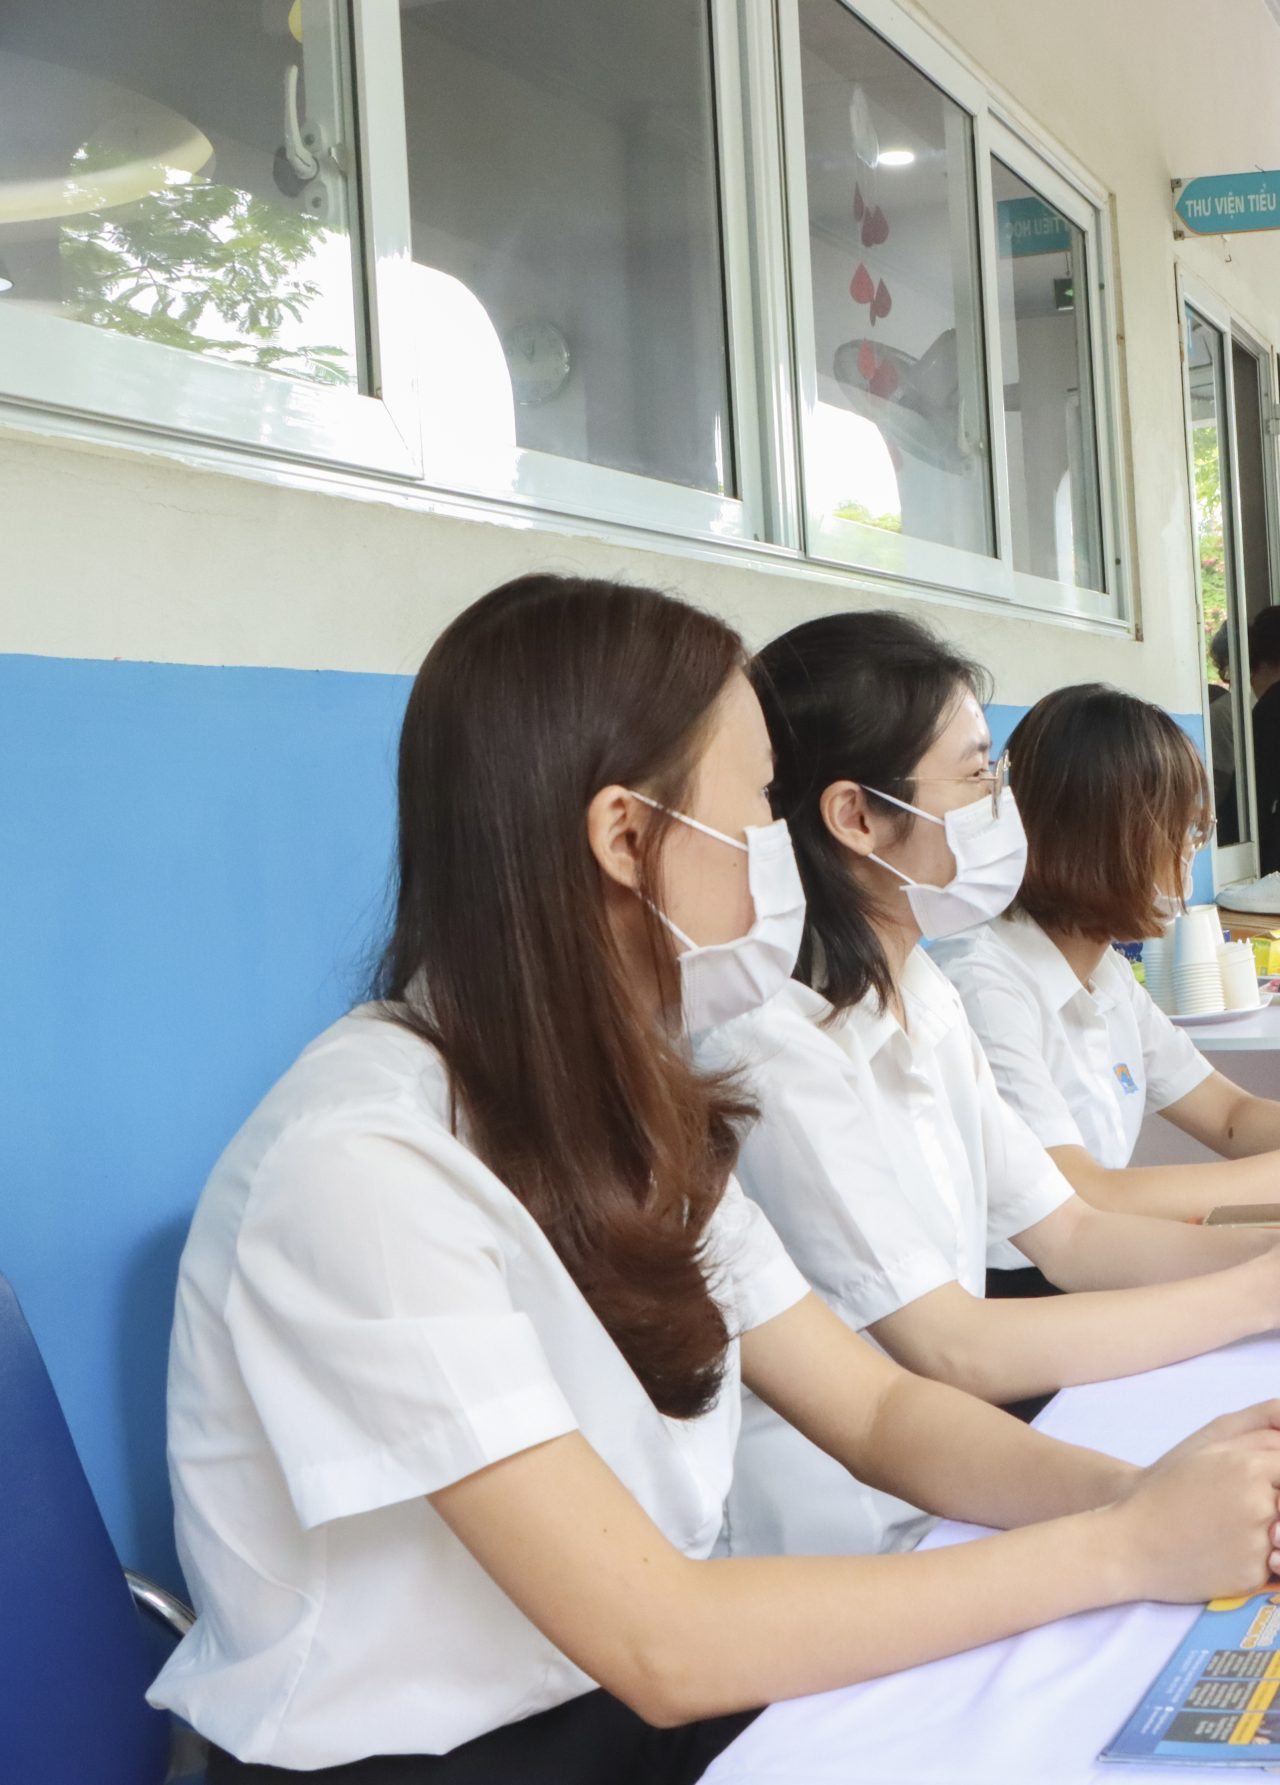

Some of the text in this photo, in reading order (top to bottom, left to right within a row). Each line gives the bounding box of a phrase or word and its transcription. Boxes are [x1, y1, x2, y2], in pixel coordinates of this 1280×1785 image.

[1185, 196, 1212, 217] THƯ
[1215, 191, 1245, 220] VIỆN
[1248, 183, 1276, 212] TIỂU
